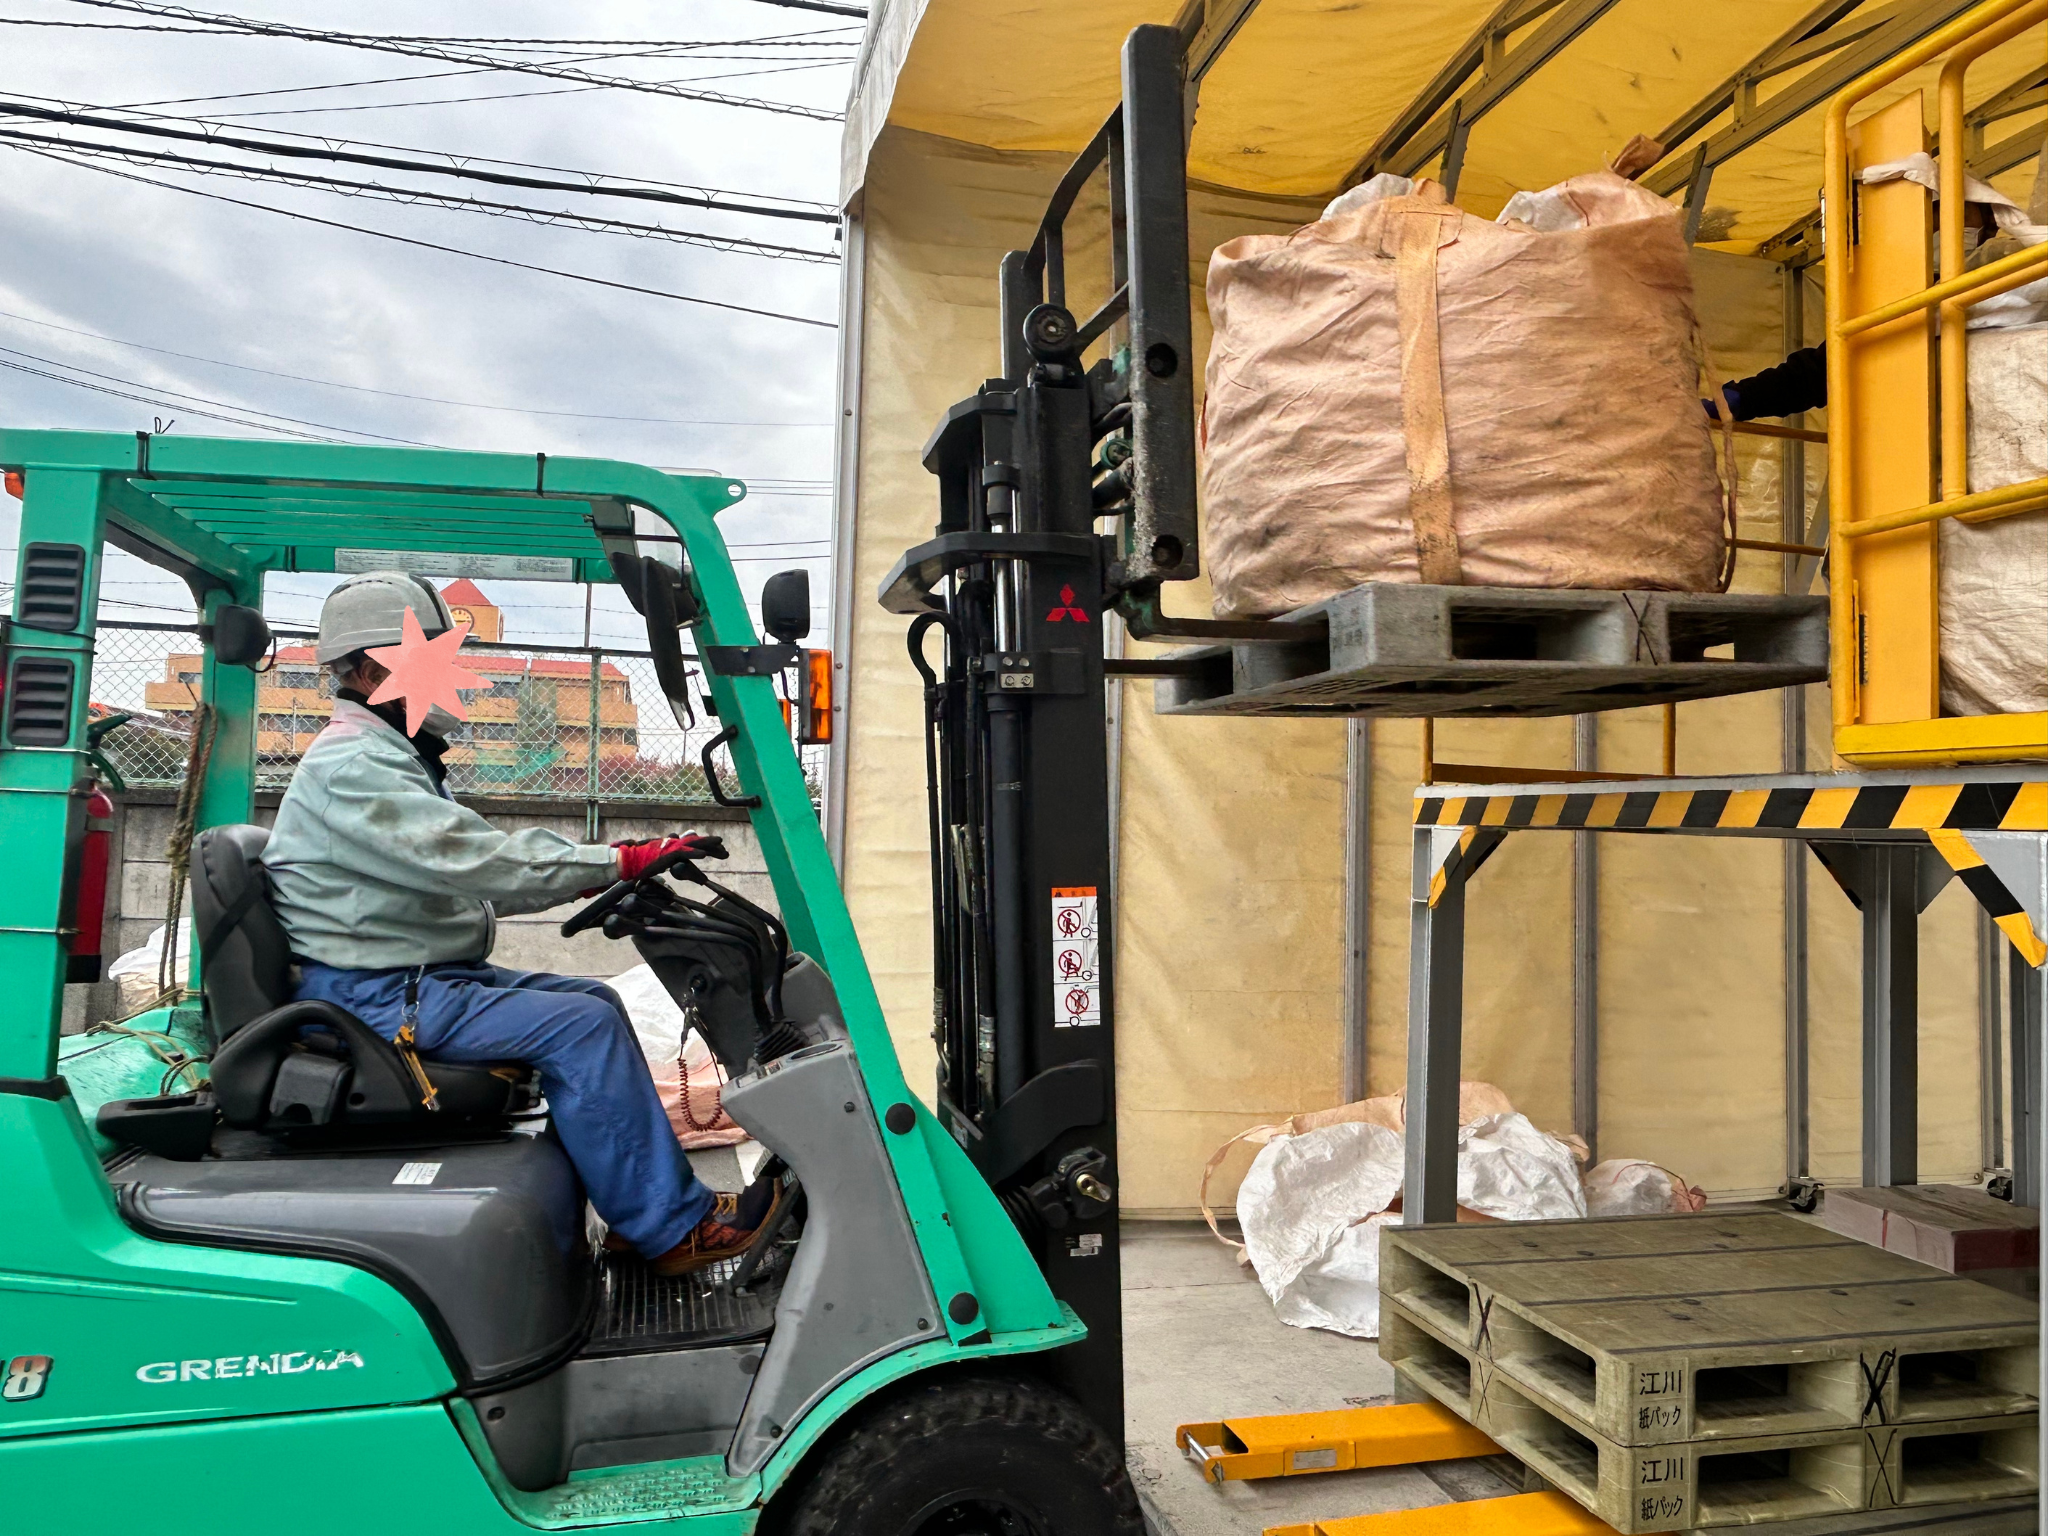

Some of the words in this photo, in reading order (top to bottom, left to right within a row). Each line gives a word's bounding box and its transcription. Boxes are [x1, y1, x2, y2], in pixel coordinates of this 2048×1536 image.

[0, 1355, 54, 1402] 8
[1639, 1369, 1682, 1395] 江川
[1639, 1405, 1681, 1429] 紙パック
[1641, 1457, 1684, 1484] 江川
[1641, 1495, 1684, 1520] 紙パック
